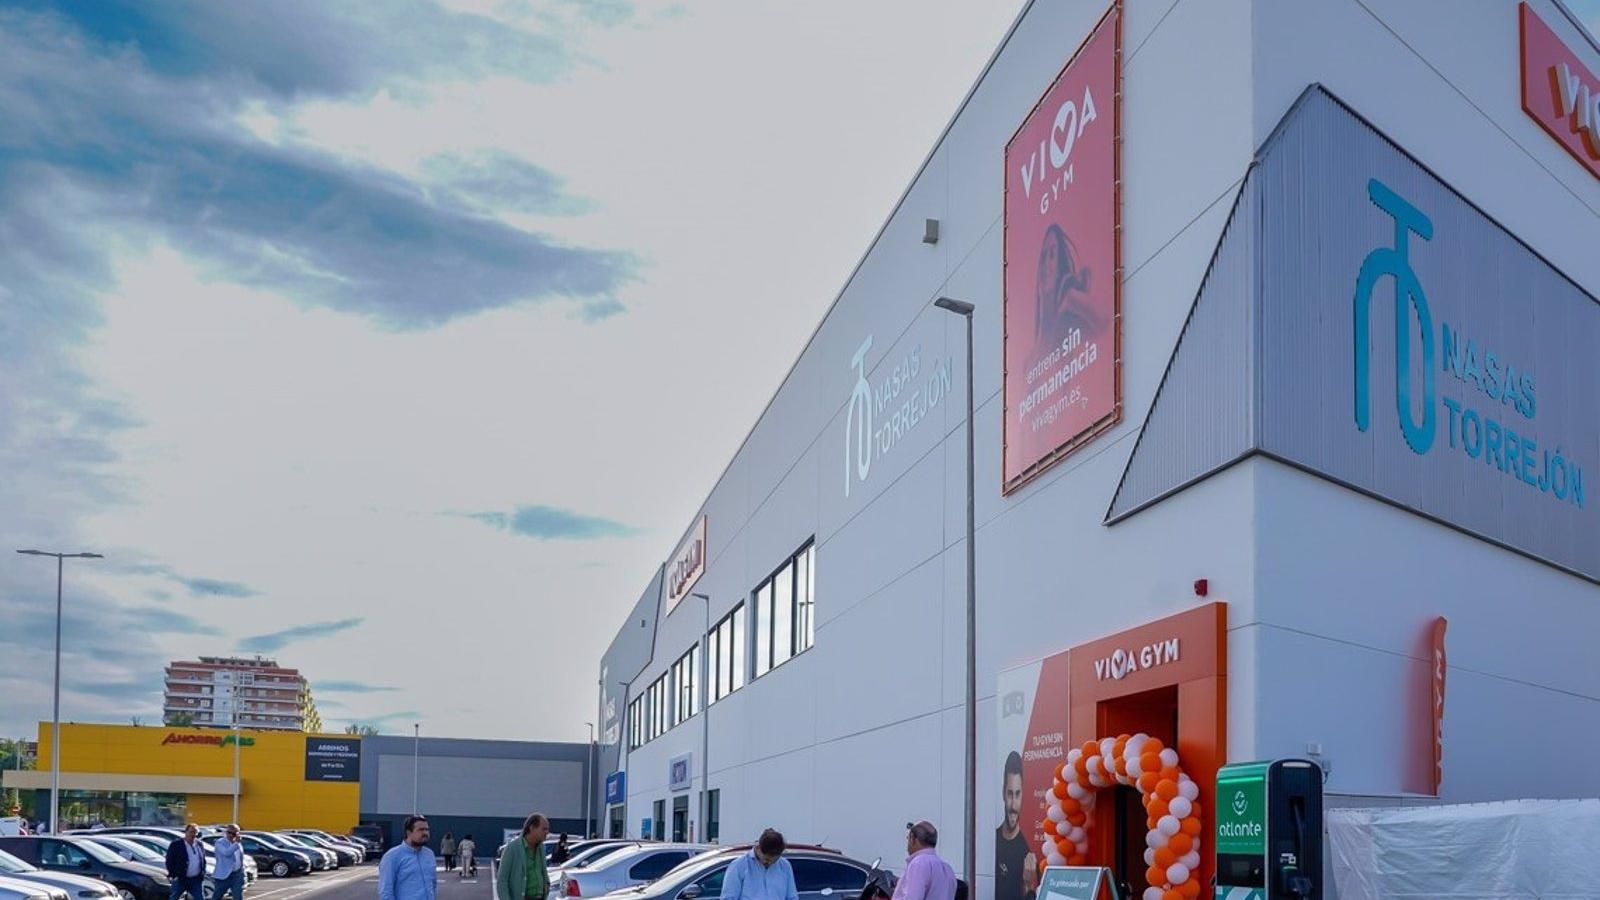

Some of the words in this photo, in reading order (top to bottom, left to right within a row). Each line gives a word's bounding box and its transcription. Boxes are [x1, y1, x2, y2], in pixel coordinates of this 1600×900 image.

[1040, 163, 1073, 214] GYM
[1062, 327, 1081, 357] sin
[1442, 321, 1537, 419] NASAS
[874, 344, 922, 417] NASAS
[874, 357, 953, 460] TORREJÓN
[1018, 341, 1097, 423] permanencia
[1443, 395, 1585, 509] TORREJÓN
[1140, 638, 1179, 669] GYM
[1219, 821, 1262, 837] atlante
